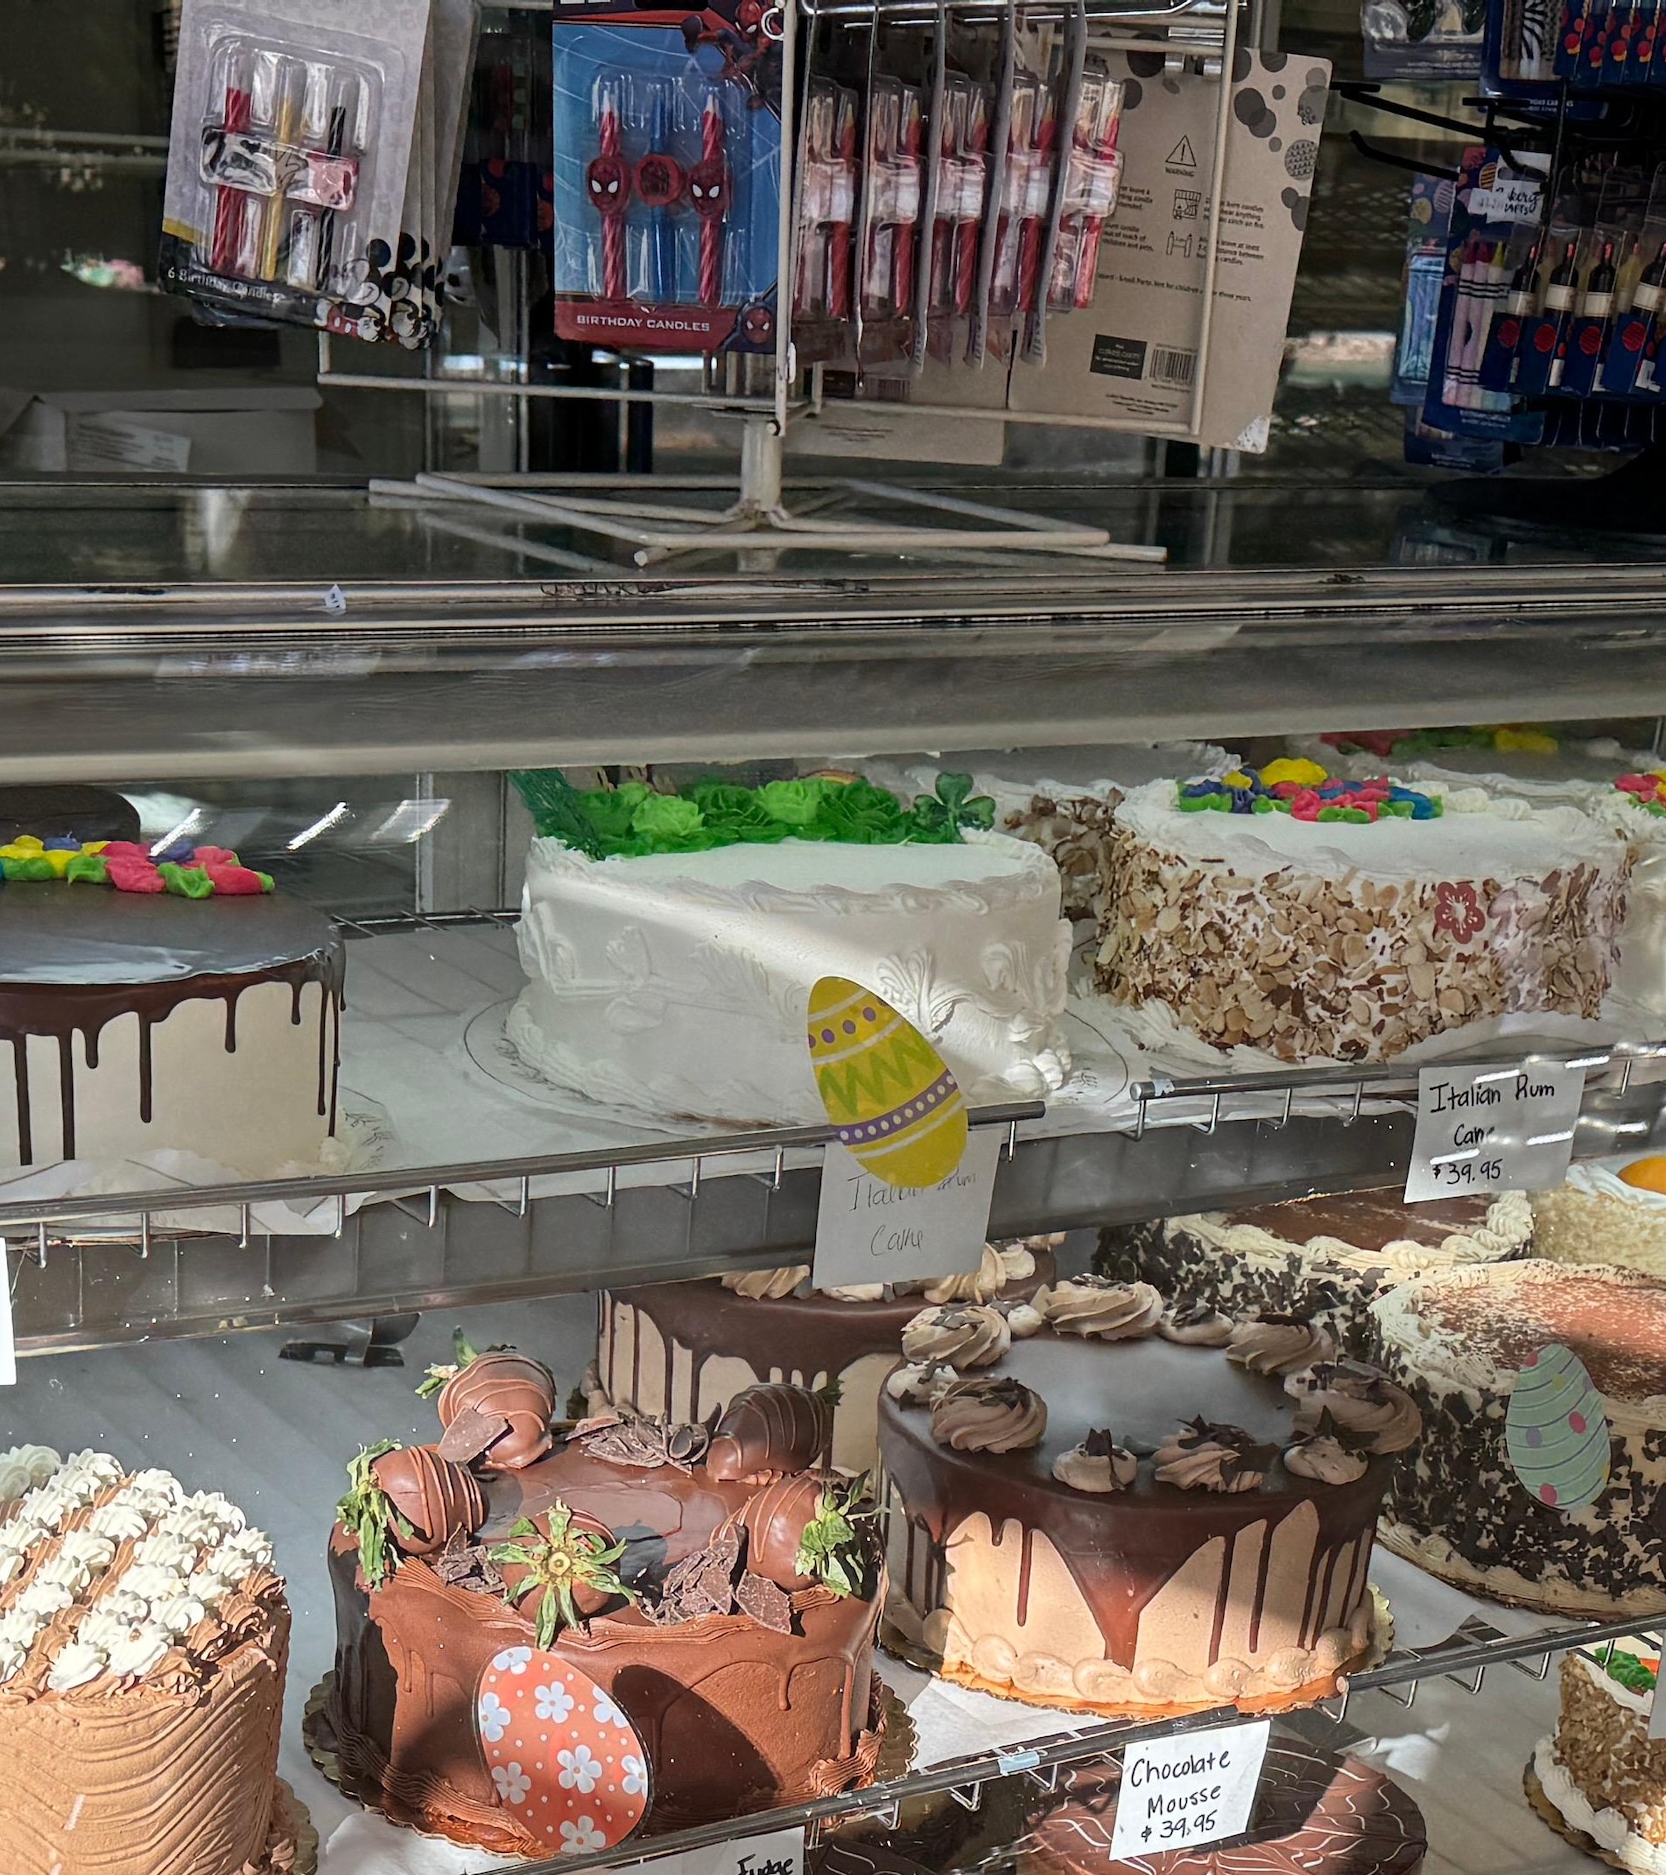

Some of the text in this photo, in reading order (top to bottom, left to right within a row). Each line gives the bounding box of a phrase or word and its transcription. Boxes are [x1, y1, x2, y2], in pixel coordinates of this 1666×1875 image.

[577, 314, 711, 332] BIRTHDAY CANDLES
[1429, 1073, 1555, 1113] Italian Rum
[870, 1224, 924, 1257] Cake
[1130, 1750, 1231, 1788] Chocolate
[1147, 1785, 1222, 1819] Mousse
